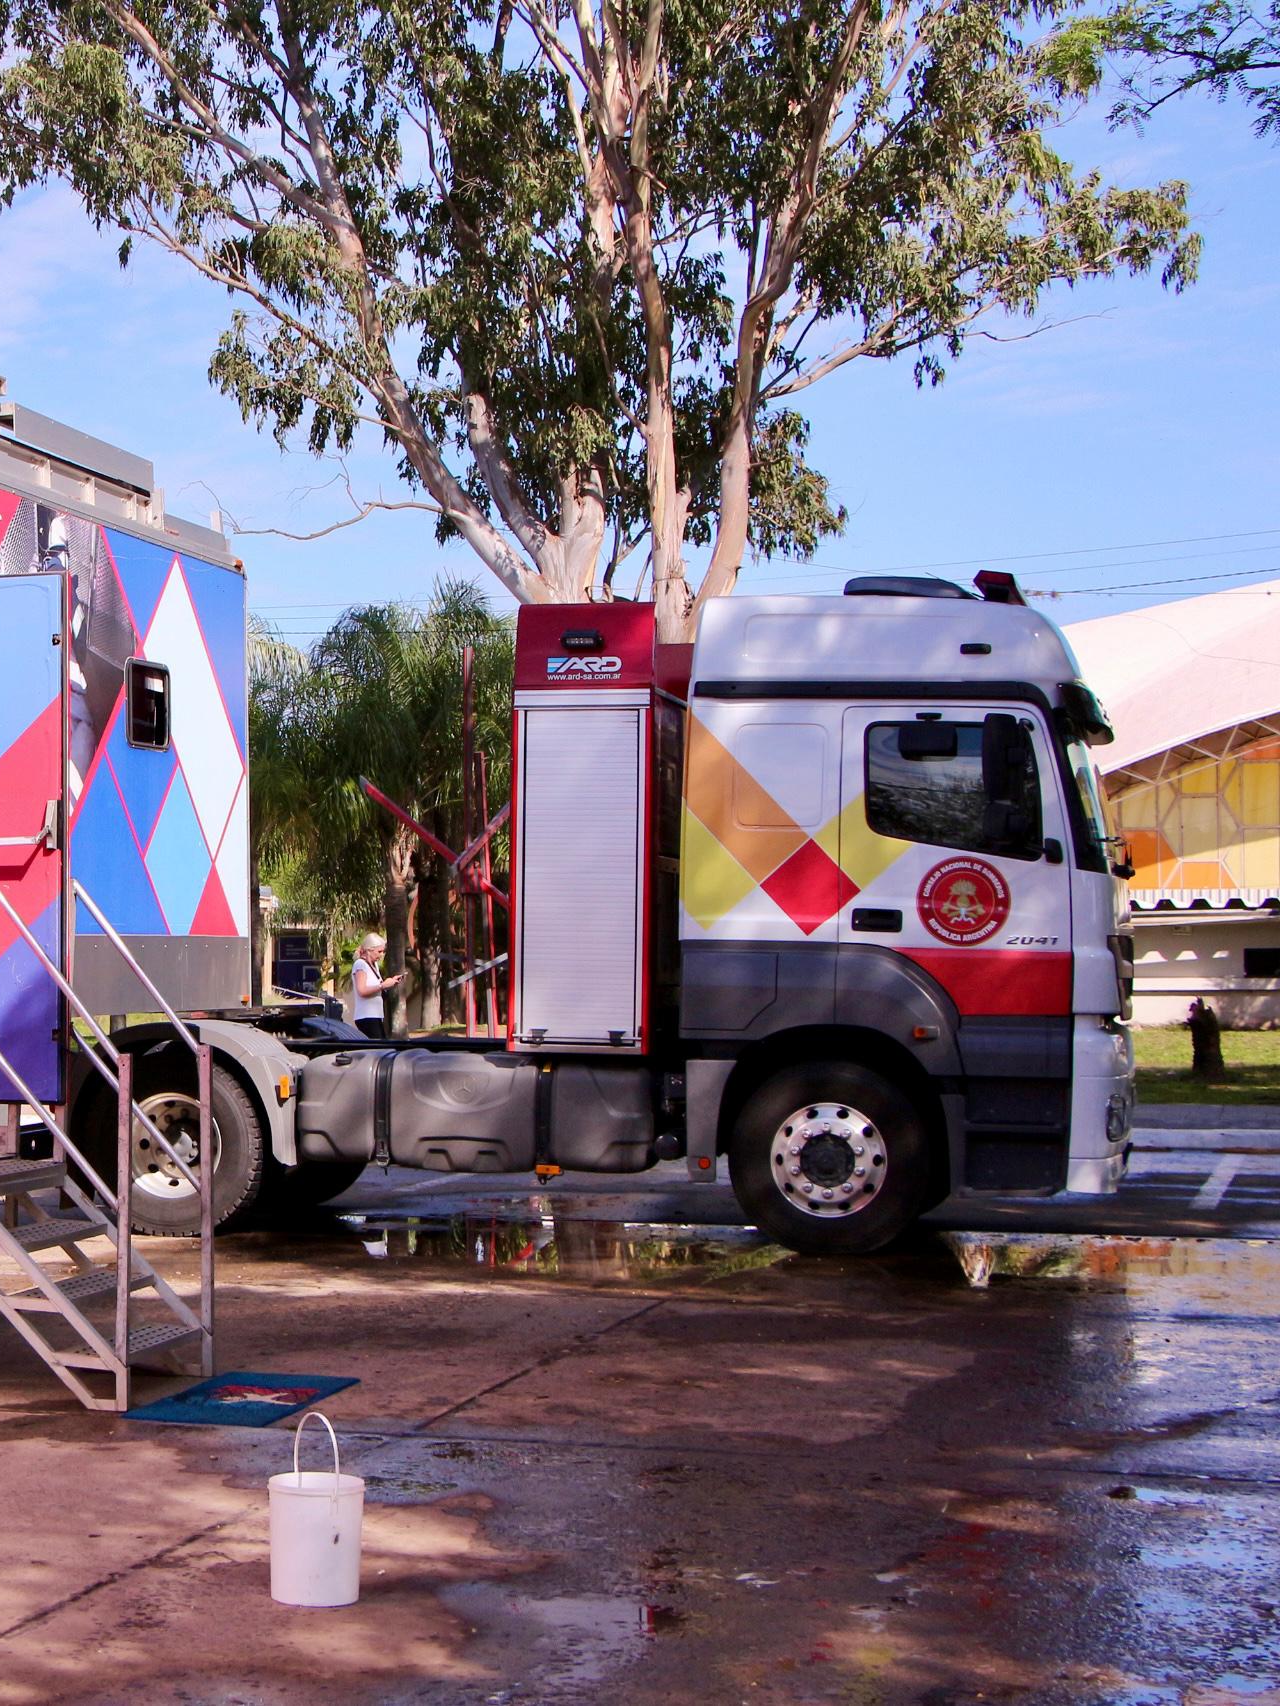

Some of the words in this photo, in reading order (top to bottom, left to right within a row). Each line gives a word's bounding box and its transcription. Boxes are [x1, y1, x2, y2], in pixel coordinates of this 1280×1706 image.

[556, 656, 622, 673] ARD
[547, 673, 622, 681] www.ard-sa.com.ar
[1006, 935, 1058, 945] 2041
